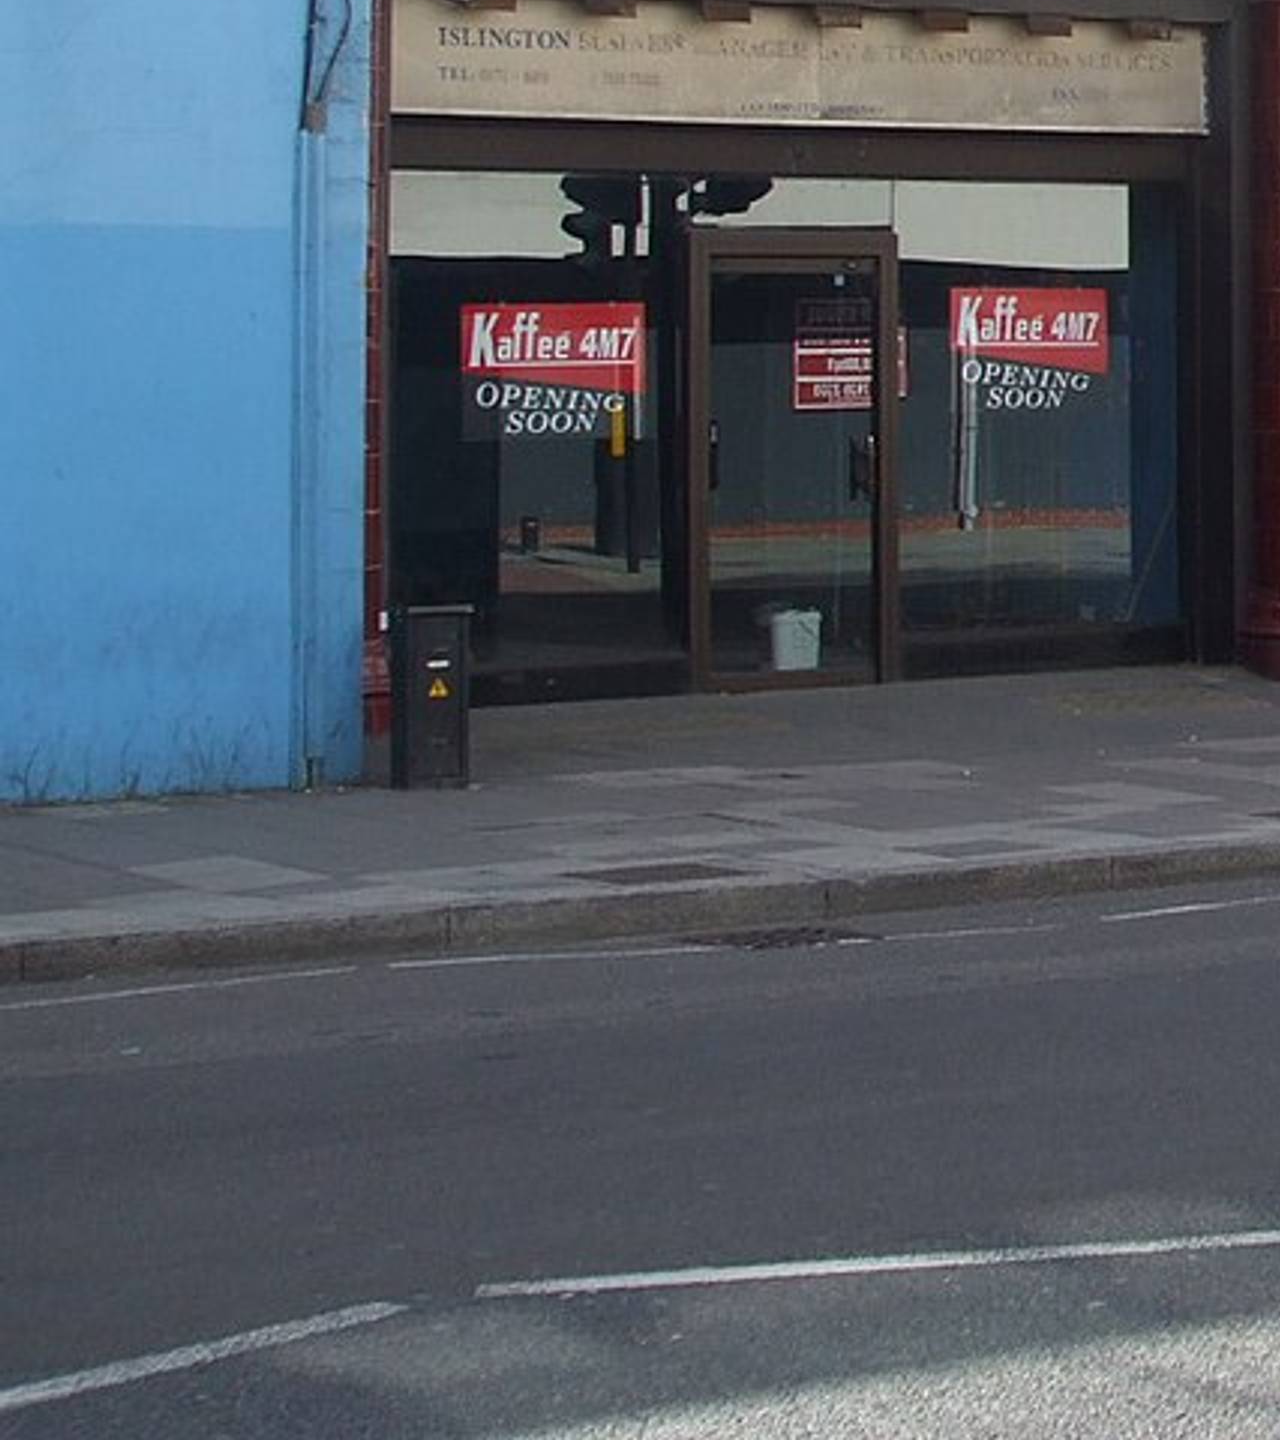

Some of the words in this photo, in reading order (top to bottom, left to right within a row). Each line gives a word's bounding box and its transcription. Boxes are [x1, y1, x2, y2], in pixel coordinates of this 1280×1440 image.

[438, 26, 570, 51] ISLINGTON
[1050, 311, 1101, 341] 4M7
[579, 327, 640, 359] 4M7
[961, 359, 1091, 392] OPENING
[475, 380, 628, 413] OPENING
[985, 385, 1066, 410] SOON
[504, 409, 598, 435] SOON
